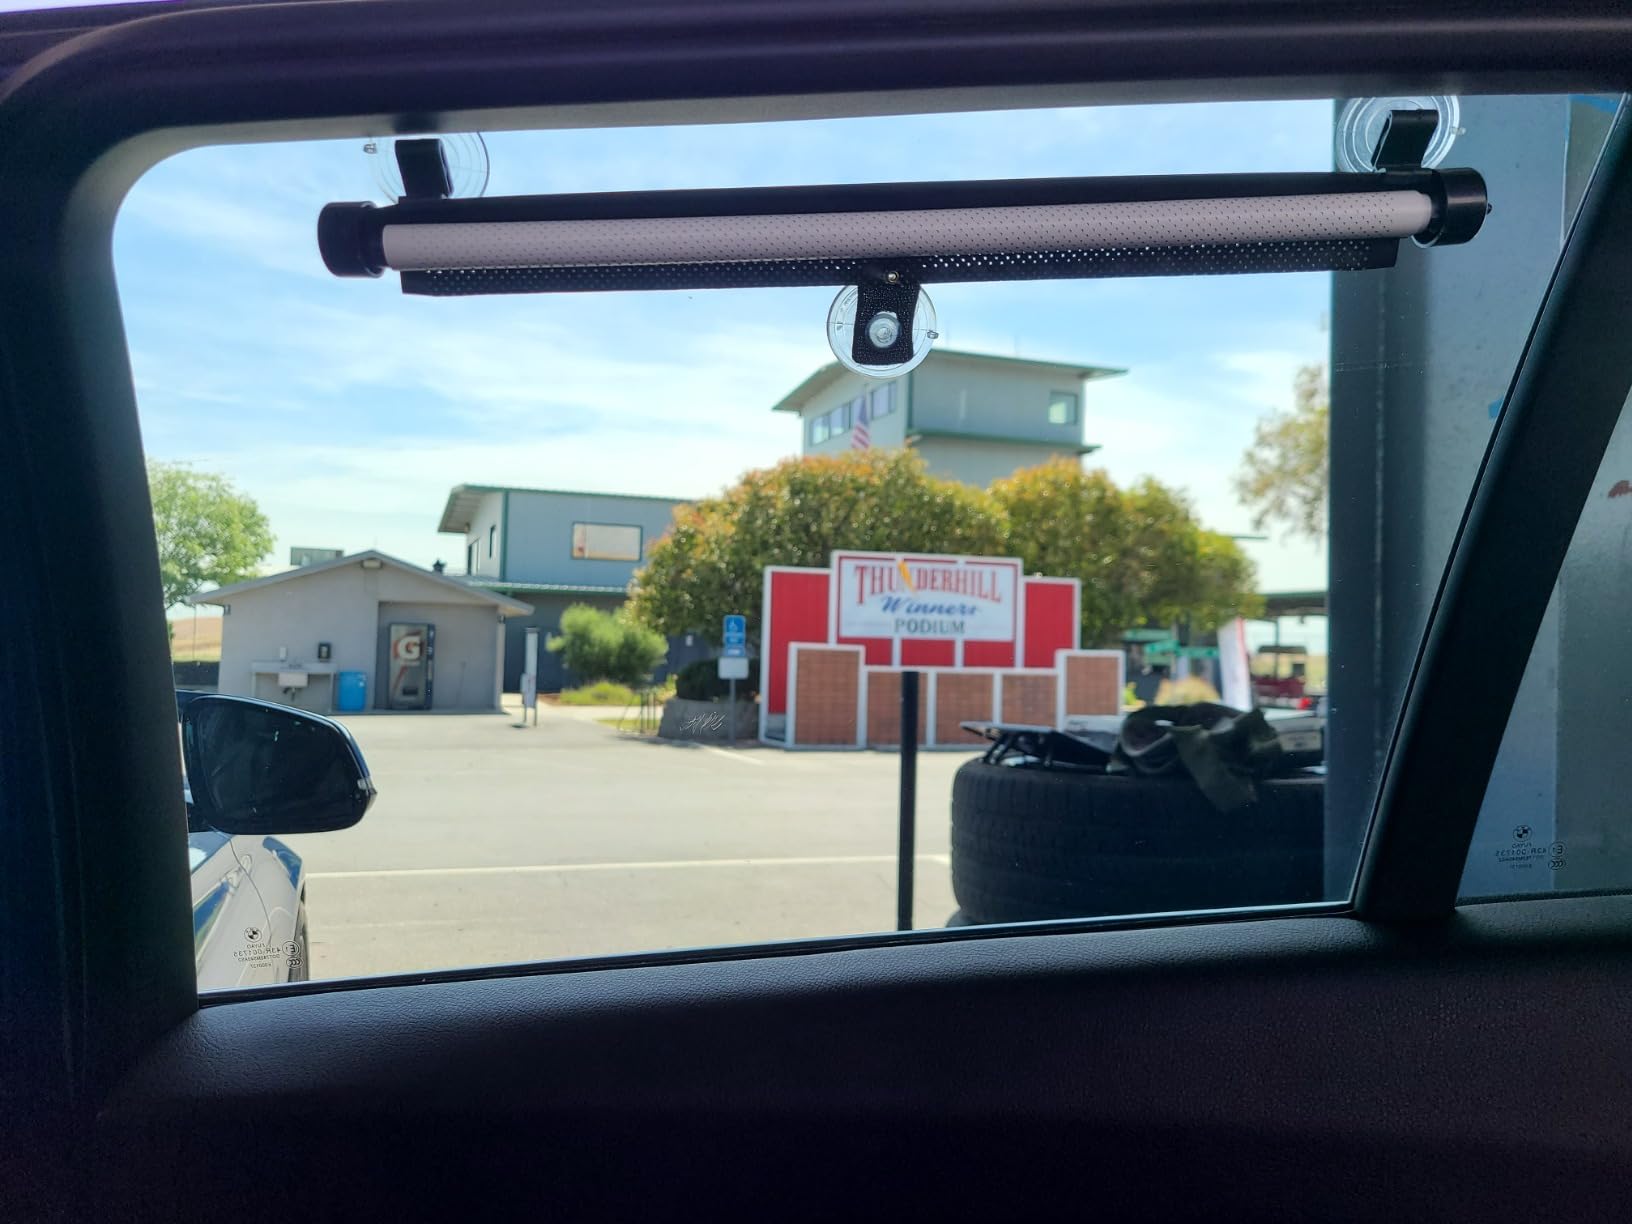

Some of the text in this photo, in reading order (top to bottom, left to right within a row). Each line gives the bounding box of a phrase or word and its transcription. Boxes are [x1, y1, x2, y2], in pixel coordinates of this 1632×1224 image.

[880, 595, 978, 616] Winners
[895, 618, 966, 634] PODIUM
[398, 636, 420, 661] G
